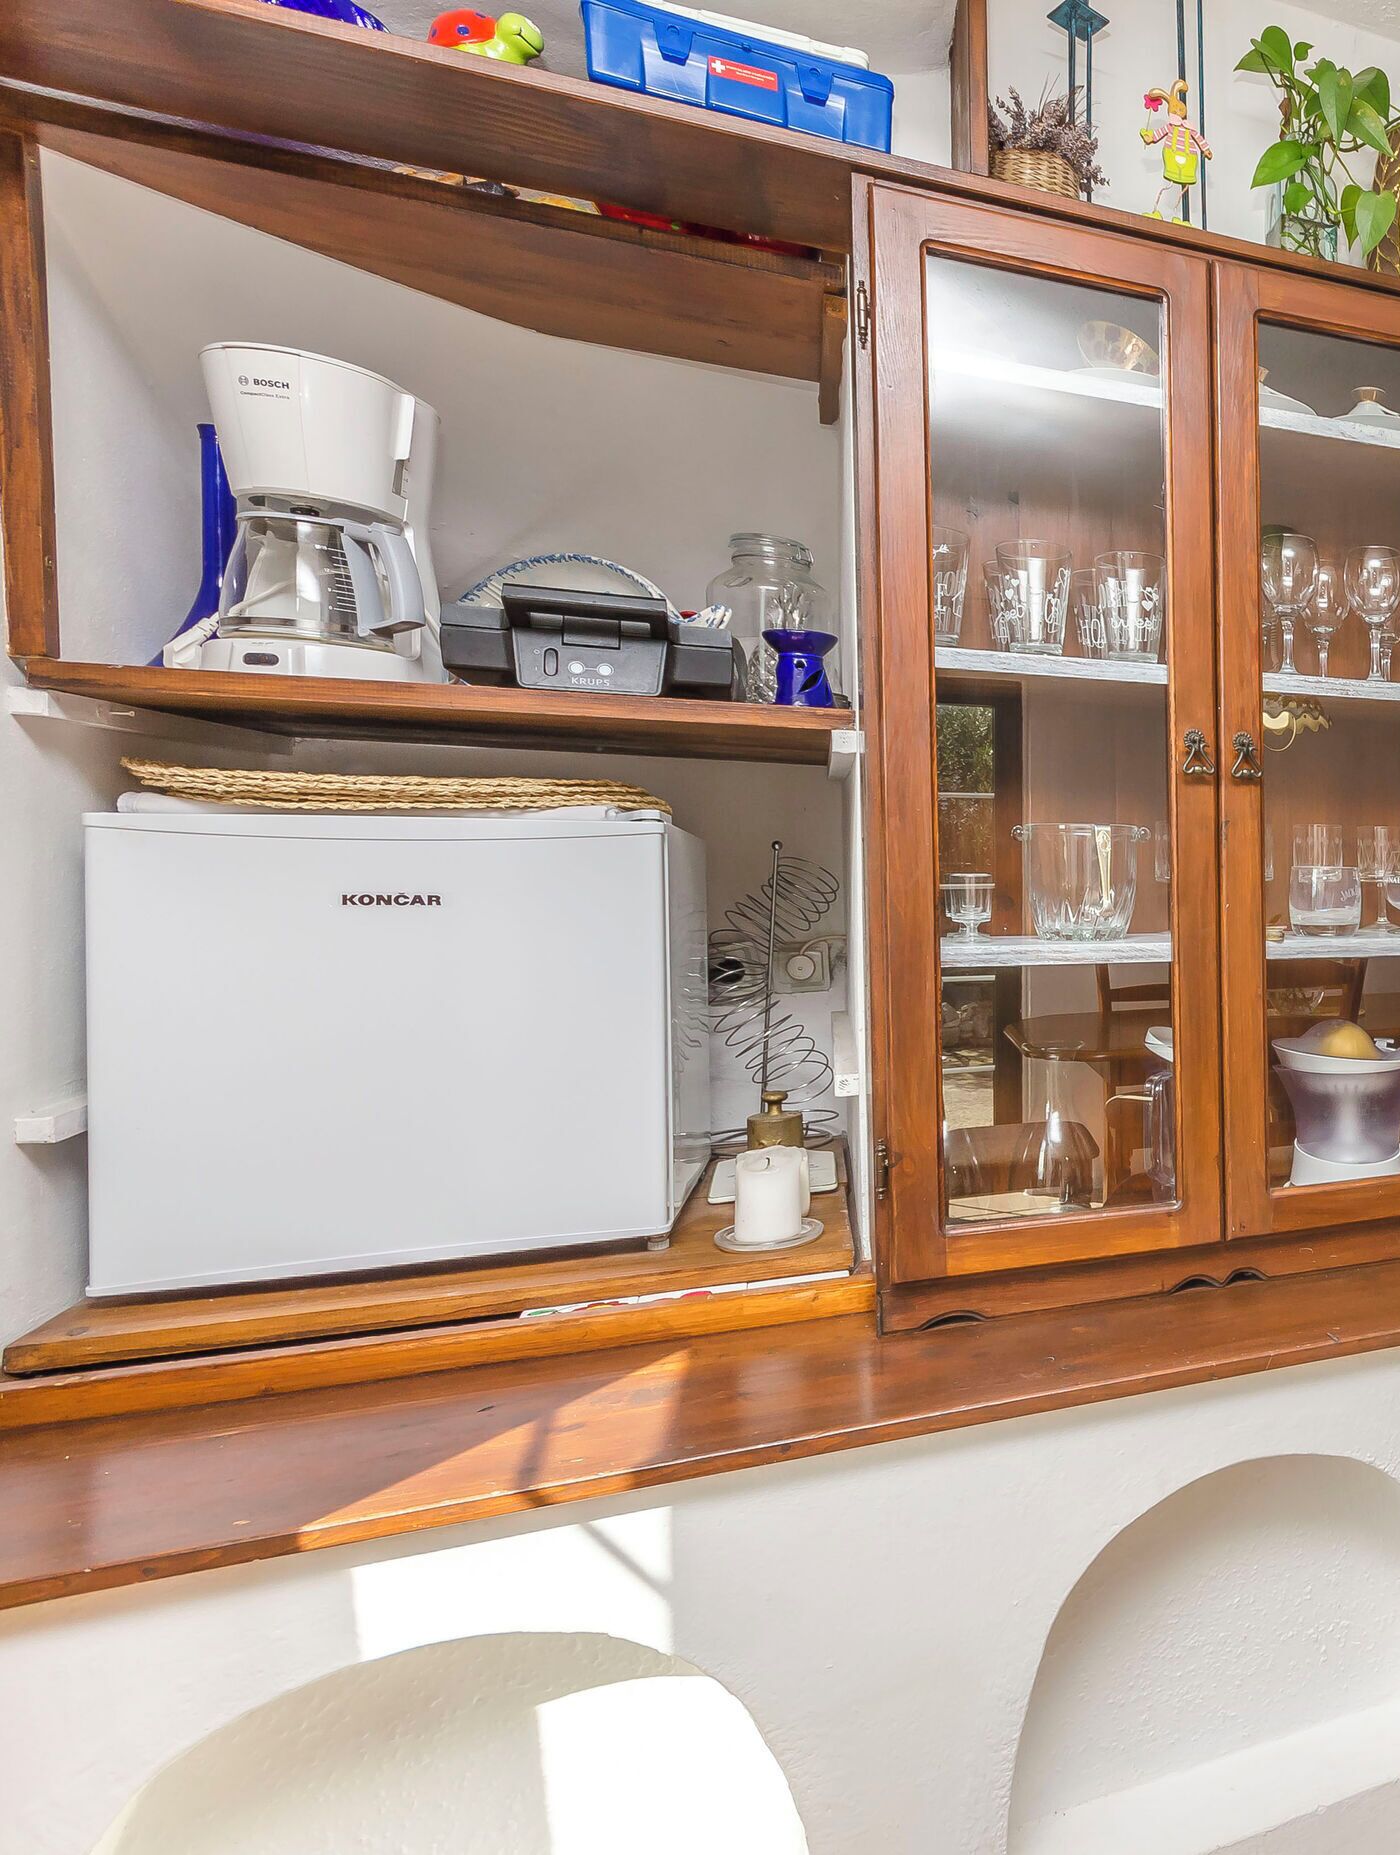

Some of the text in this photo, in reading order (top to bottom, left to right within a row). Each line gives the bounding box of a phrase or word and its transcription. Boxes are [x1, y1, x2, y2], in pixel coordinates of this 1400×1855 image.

[252, 378, 290, 390] BOSCH
[571, 677, 610, 687] KRUPS
[341, 892, 442, 906] KONČAR
